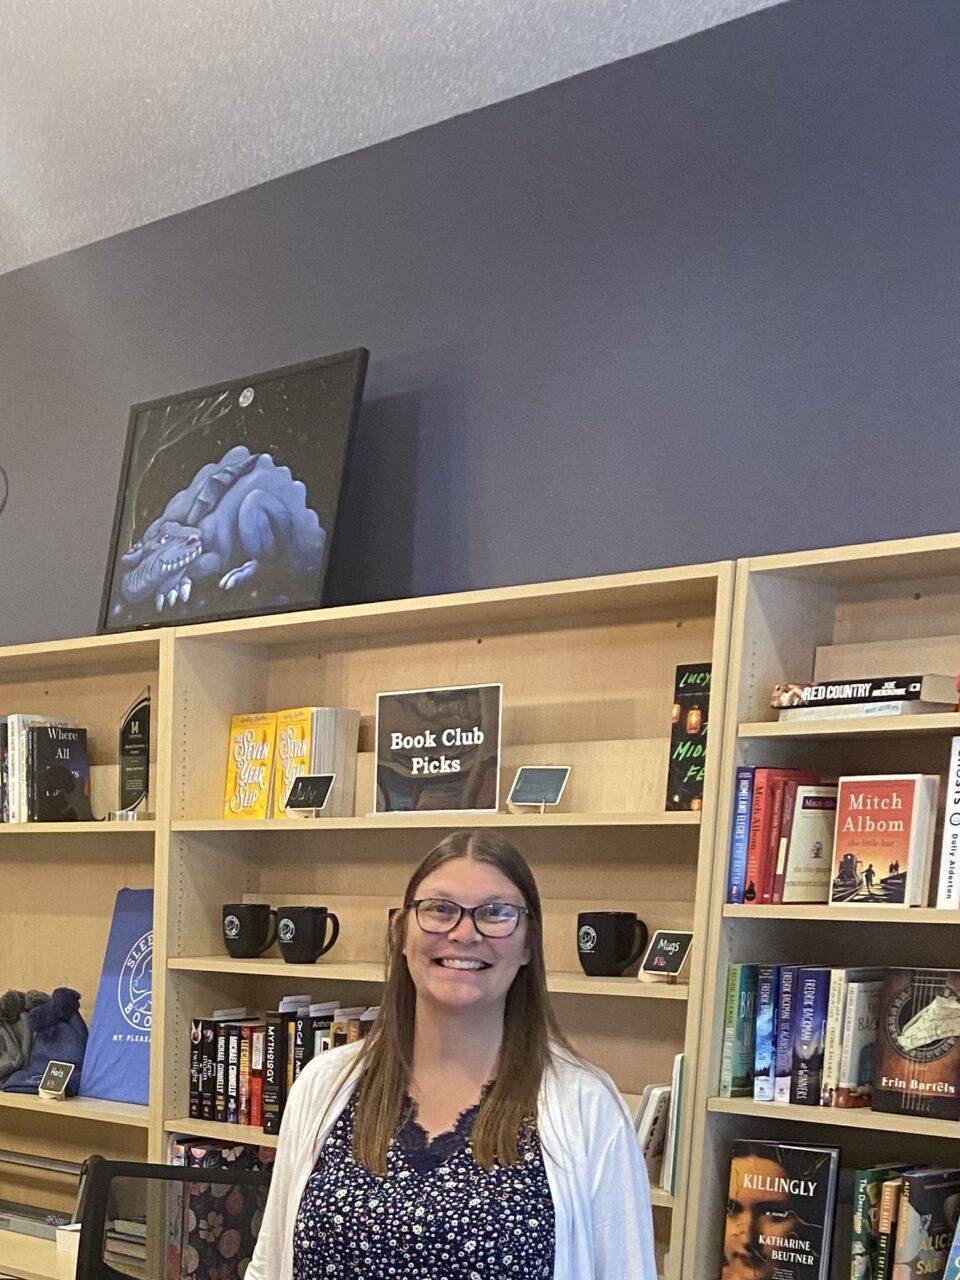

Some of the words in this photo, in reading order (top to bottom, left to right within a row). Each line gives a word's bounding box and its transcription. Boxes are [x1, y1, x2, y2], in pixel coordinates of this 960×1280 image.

[803, 685, 826, 701] RED
[826, 682, 872, 699] COUNTRY
[48, 728, 78, 740] Where
[390, 730, 437, 750] Book
[442, 726, 485, 746] Club
[56, 748, 70, 759] All
[411, 755, 461, 775] Picks
[738, 780, 749, 813] HOMELAND
[849, 793, 902, 810] Mitch
[842, 816, 904, 832] Albom
[950, 833, 958, 857] Dolly
[946, 860, 956, 900] Alderton
[658, 939, 681, 955] Mugs
[803, 979, 816, 1006] FREDRIK
[297, 1020, 303, 1031] On
[800, 1007, 814, 1041] BACKMAN
[217, 1036, 226, 1062] MICHAEL
[228, 1036, 238, 1064] MICHAEL
[266, 1026, 275, 1084] MYTHOLOGY
[191, 1050, 199, 1083] twilight
[216, 1063, 225, 1094] CONNELLY
[228, 1065, 237, 1096] CONNELLY
[796, 1069, 808, 1099] WINNERS
[881, 1077, 906, 1088] Erin
[910, 1080, 955, 1093] Bartels
[743, 1174, 817, 1197] KILLINGLY
[859, 1178, 867, 1193] The
[759, 1234, 811, 1251] KATHARINE
[772, 1249, 814, 1266] BEUTNER
